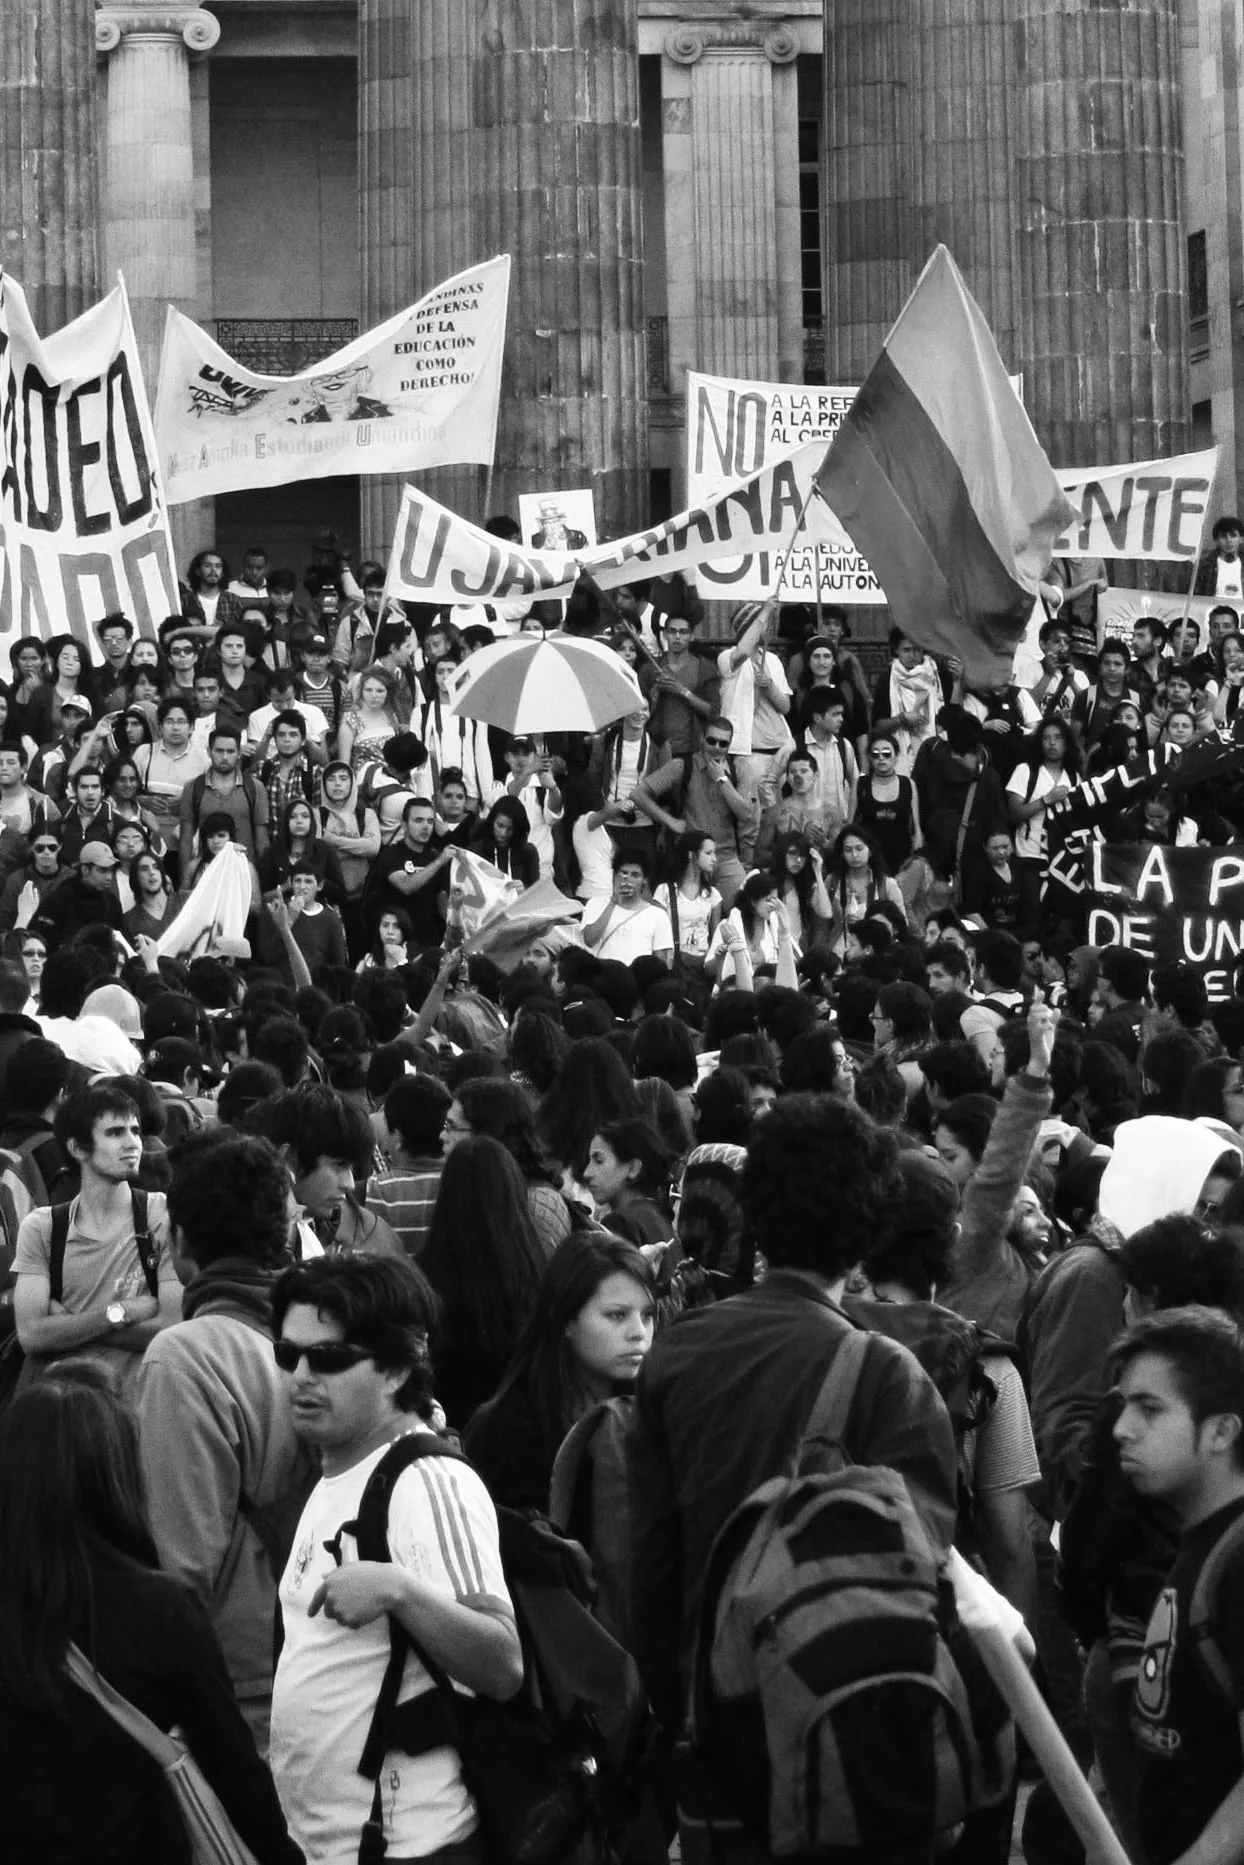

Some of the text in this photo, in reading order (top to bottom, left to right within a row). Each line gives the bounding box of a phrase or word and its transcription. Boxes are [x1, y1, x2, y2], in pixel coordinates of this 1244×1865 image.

[416, 299, 478, 319] DEFENSA
[416, 320, 456, 335] DE LA
[394, 335, 476, 354] EDUCACIÓN
[415, 357, 456, 372] COMO
[771, 394, 857, 411] A LA REF
[772, 411, 846, 427] A LA PRI
[696, 386, 767, 478] NO
[771, 428, 791, 444] AL
[791, 556, 812, 571] LA
[818, 556, 872, 572] UNIVE
[792, 574, 813, 589] LA
[819, 573, 881, 590] AUTON
[1209, 855, 1244, 906] P
[1088, 909, 1244, 964] DE UN
